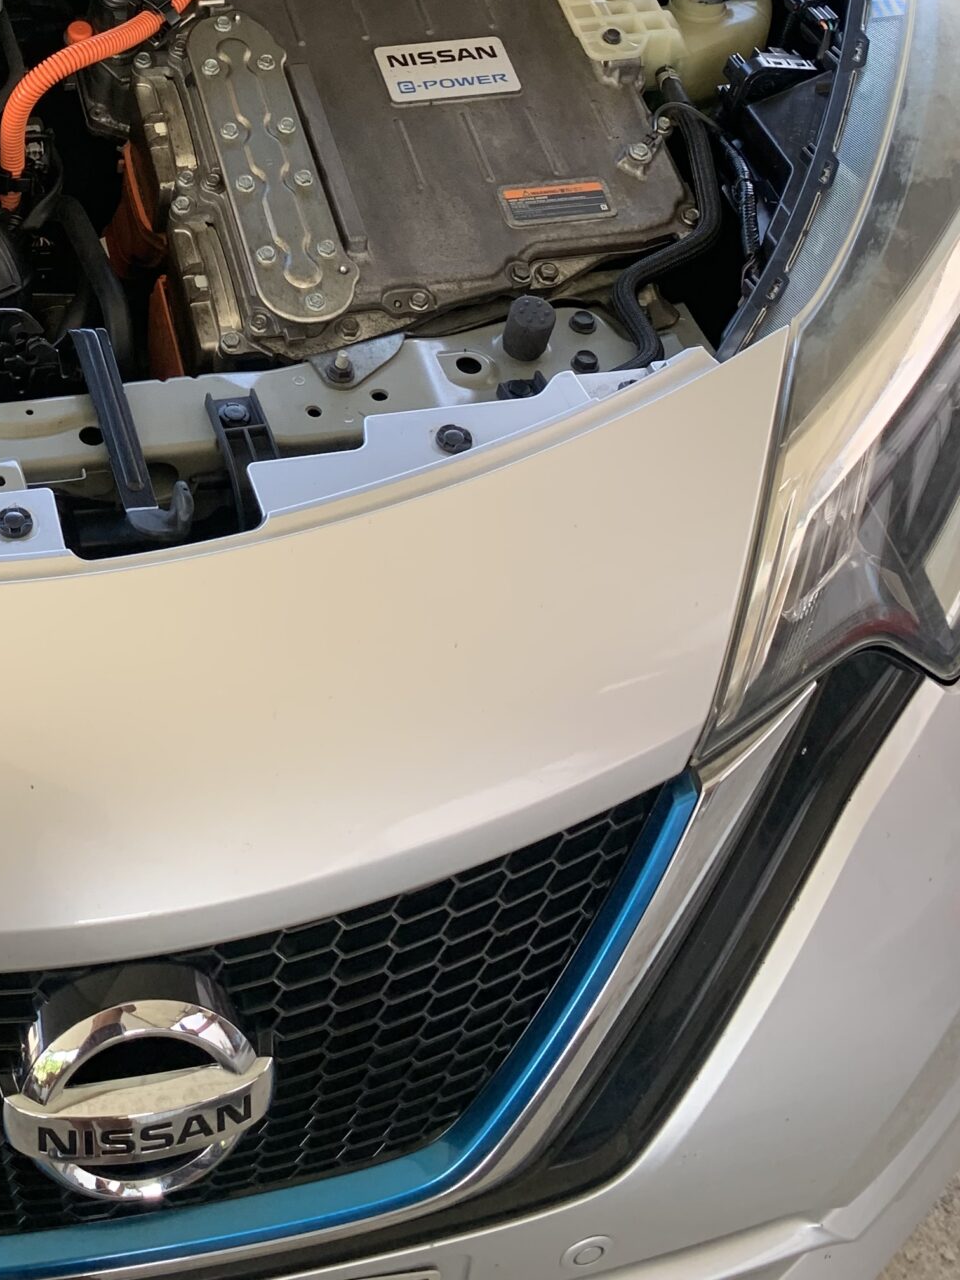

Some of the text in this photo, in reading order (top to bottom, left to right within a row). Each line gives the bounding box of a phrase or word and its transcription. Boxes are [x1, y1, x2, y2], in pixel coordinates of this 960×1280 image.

[386, 45, 498, 68] NISSAN
[397, 73, 510, 94] e-POWER
[38, 1094, 252, 1156] NISSAN
